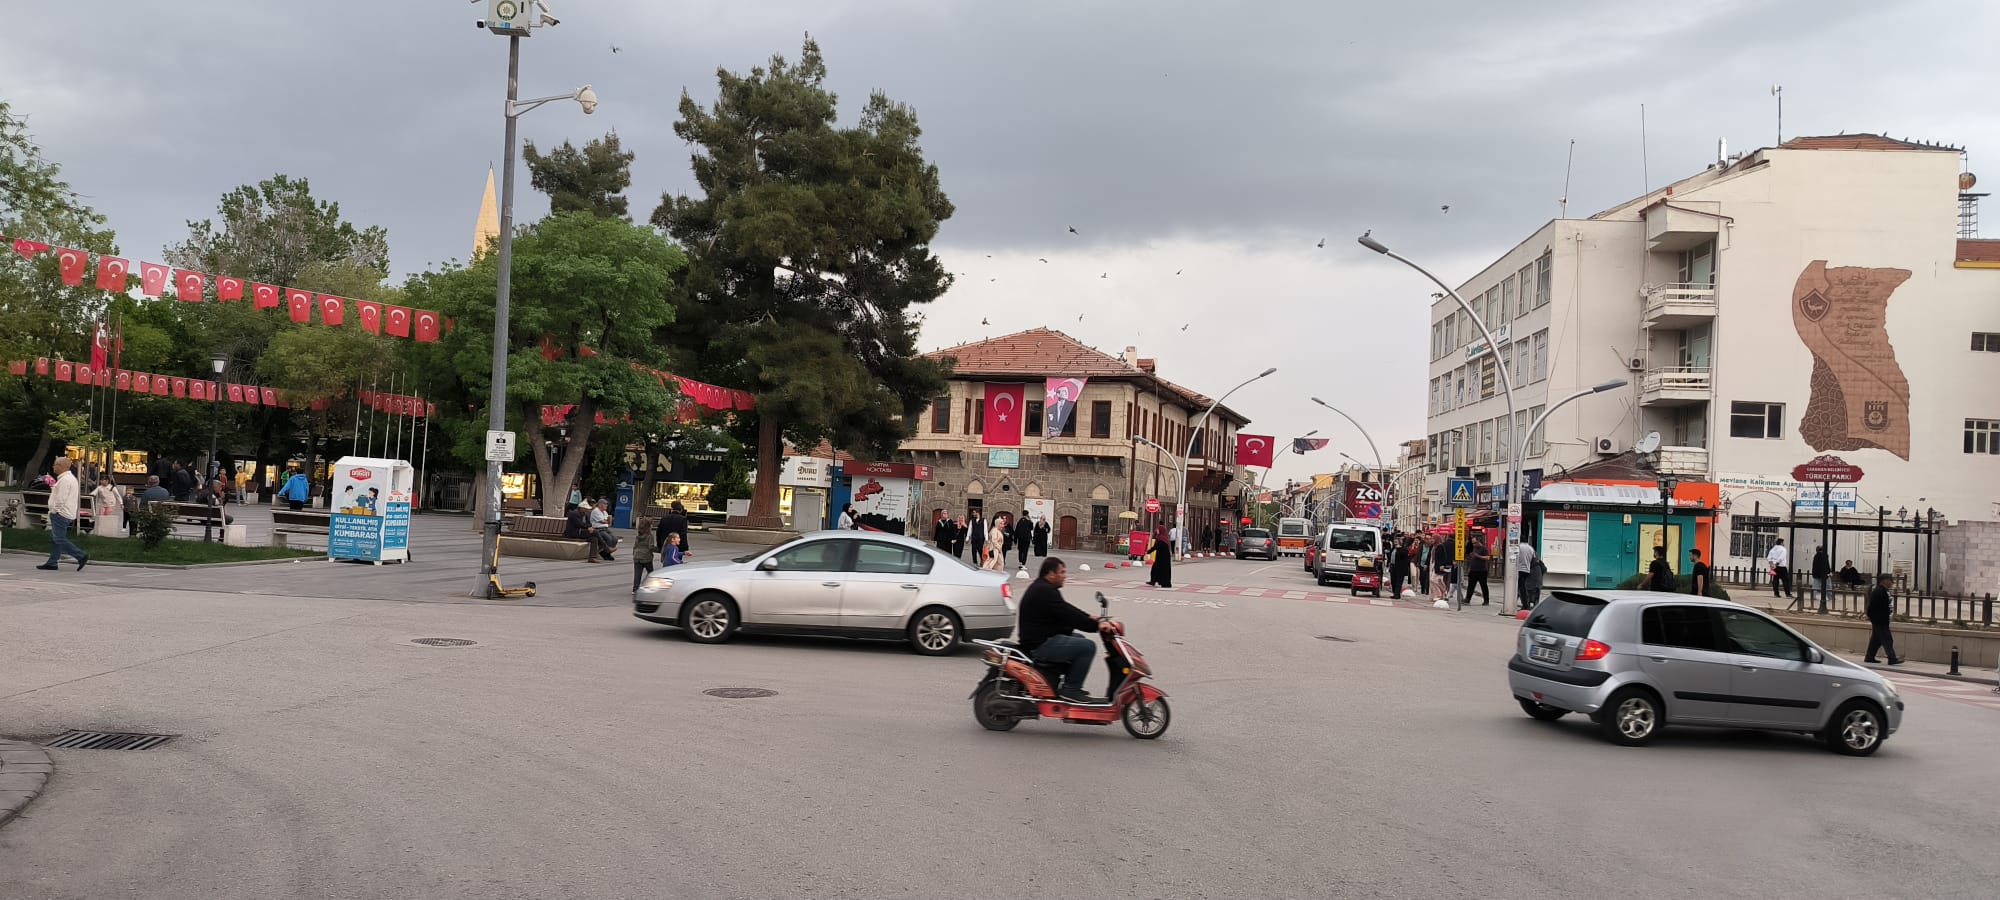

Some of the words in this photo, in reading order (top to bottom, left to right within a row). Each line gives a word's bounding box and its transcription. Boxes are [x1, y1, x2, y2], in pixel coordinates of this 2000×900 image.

[1805, 472, 1831, 480] TÜRKÇE
[335, 517, 379, 526] KULLANILMIŞ
[334, 530, 378, 539] KUMBARASI
